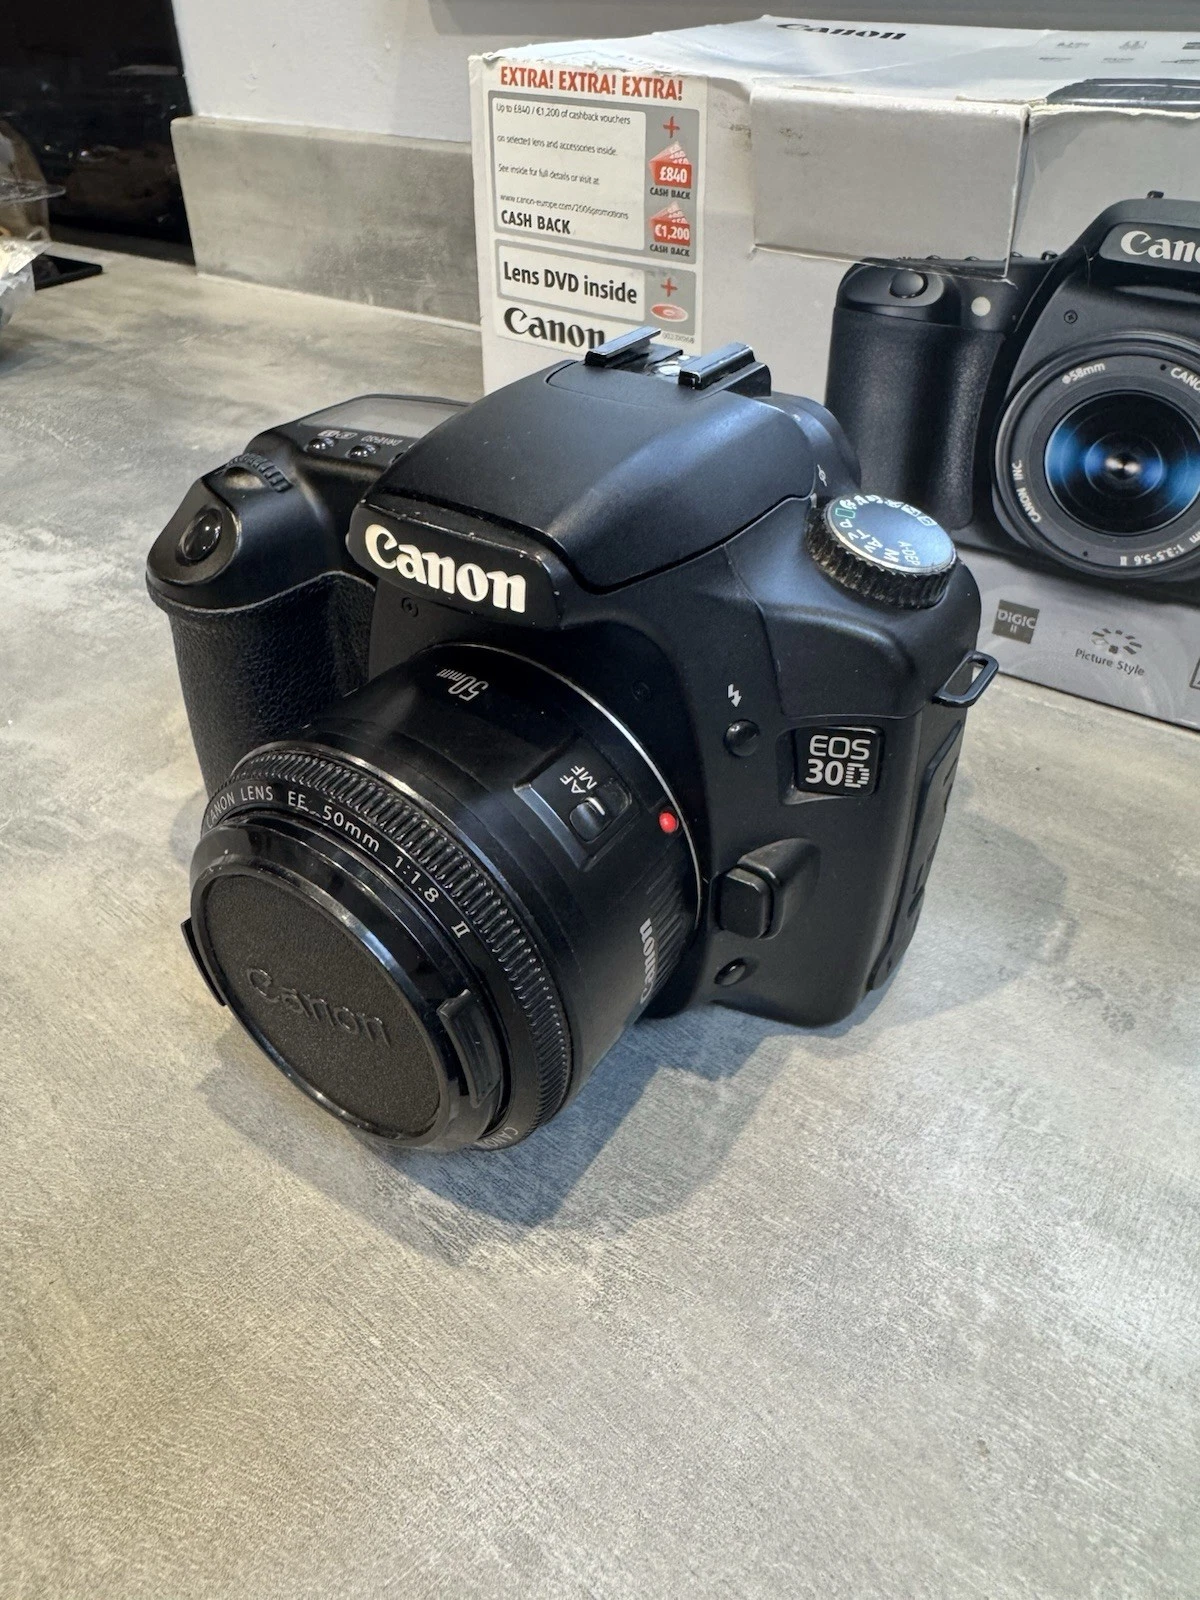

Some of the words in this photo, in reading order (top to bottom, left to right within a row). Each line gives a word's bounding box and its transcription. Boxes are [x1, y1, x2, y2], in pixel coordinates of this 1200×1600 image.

[776, 24, 907, 40] Canon
[501, 66, 554, 88] EXTRA!
[559, 70, 617, 95] EXTRA!
[622, 75, 683, 101] EXTRA!
[496, 103, 505, 113] Up
[514, 104, 531, 115] £840
[561, 109, 568, 118] of
[569, 111, 599, 122] cashback
[600, 114, 631, 125] vouchers
[507, 136, 530, 146] selected
[546, 140, 558, 149] and
[559, 142, 596, 153] accessories
[499, 163, 509, 172] See
[511, 166, 528, 175] inside
[550, 171, 570, 181] details
[659, 165, 688, 184] £840
[650, 187, 669, 198] CASH
[671, 189, 691, 200] BACK
[501, 209, 533, 229] CASH
[537, 215, 571, 235] BACK
[654, 223, 690, 241] €1,200
[649, 243, 668, 254] CASH
[670, 246, 690, 257] BACK
[504, 261, 540, 286] Lens
[544, 269, 579, 293] DVD
[583, 275, 638, 304] inside
[503, 307, 605, 349] Canon
[1016, 487, 1042, 523] CANON
[883, 547, 900, 563] M
[897, 540, 921, 566] A-DEP
[364, 523, 527, 614] Canon
[997, 609, 1036, 630] DIGIC
[1074, 647, 1114, 668] Picture
[1116, 660, 1146, 677] Style
[436, 668, 490, 702] 50mm
[809, 734, 871, 761] EOS
[559, 774, 587, 795] AF
[570, 765, 598, 791] MF
[805, 758, 870, 789] 30D
[206, 791, 236, 829] CANON
[240, 785, 274, 802] LENS
[322, 804, 380, 852] 50mm
[394, 855, 440, 903] 1:1.8
[451, 920, 471, 939] II
[639, 917, 656, 1004] Canon
[247, 967, 391, 1050] Canon
